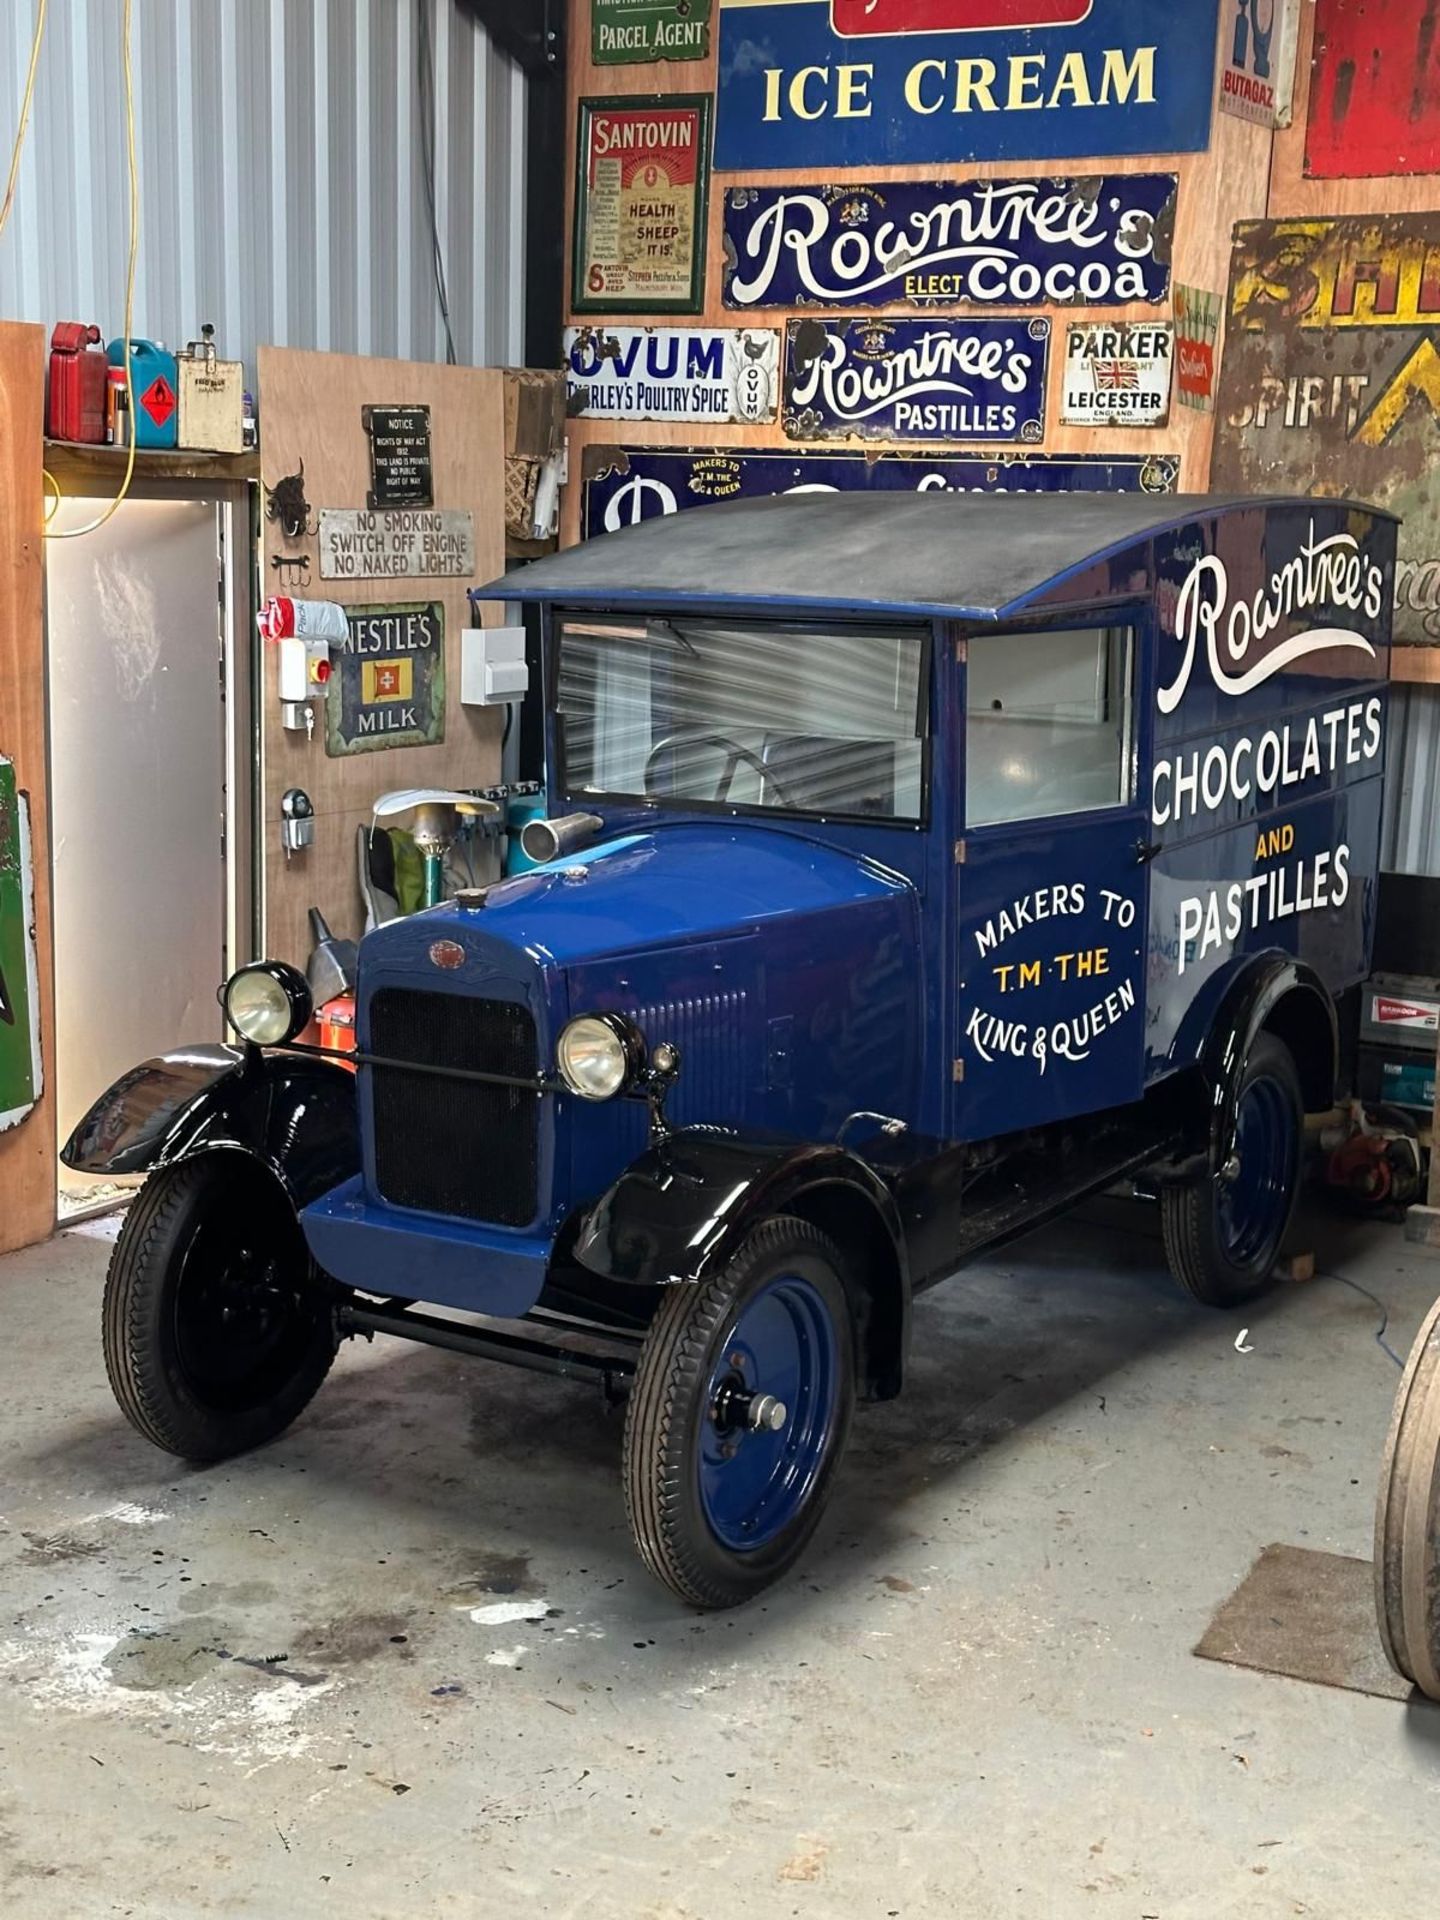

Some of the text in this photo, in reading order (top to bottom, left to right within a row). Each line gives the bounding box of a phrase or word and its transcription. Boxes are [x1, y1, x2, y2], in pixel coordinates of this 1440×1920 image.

[599, 20, 704, 50] PARCEL AGENT
[761, 46, 1158, 122] ICE CREAM
[1223, 70, 1274, 109] BUTAGAZ
[629, 203, 676, 218] HEALTH
[637, 226, 680, 240] SHEEP
[731, 183, 1157, 304] Rowntree's
[647, 244, 658, 256] IT
[904, 257, 1150, 300] ELECT Cocoa
[570, 334, 726, 380] OVUM
[1068, 332, 1170, 358] PARKER
[791, 331, 1033, 420] Rowntree's
[566, 381, 730, 413] TRLEY'S POULTRY SPICE
[746, 368, 759, 415] OVUM
[1068, 391, 1162, 409] LEICESTER
[388, 419, 415, 430] NOTICE
[894, 402, 1017, 432] PASTILLES
[376, 437, 426, 446] RIGHTS OF WAY ACT
[376, 457, 430, 466] THIS LAND IS PRIVATE
[390, 467, 417, 476] NO PUBLIC
[692, 458, 740, 472] MAKERS TO
[386, 477, 421, 486] RIGHT OF WAY
[714, 481, 741, 496] QUEEN
[356, 512, 442, 532] NO SMOKING
[330, 533, 467, 553] SWITCH OFF ENGINE
[334, 554, 464, 575] NO NAKED LIGHTS
[1156, 517, 1383, 714] Rowntree's
[358, 707, 418, 733] MILK
[1150, 697, 1382, 826] CHOCOLATES
[1254, 823, 1295, 861] AND
[974, 883, 1136, 959] MAKERS TO
[1177, 843, 1351, 977] PASTILLES
[1053, 947, 1110, 981] THE
[965, 978, 1136, 1076] KING & QUEEN
